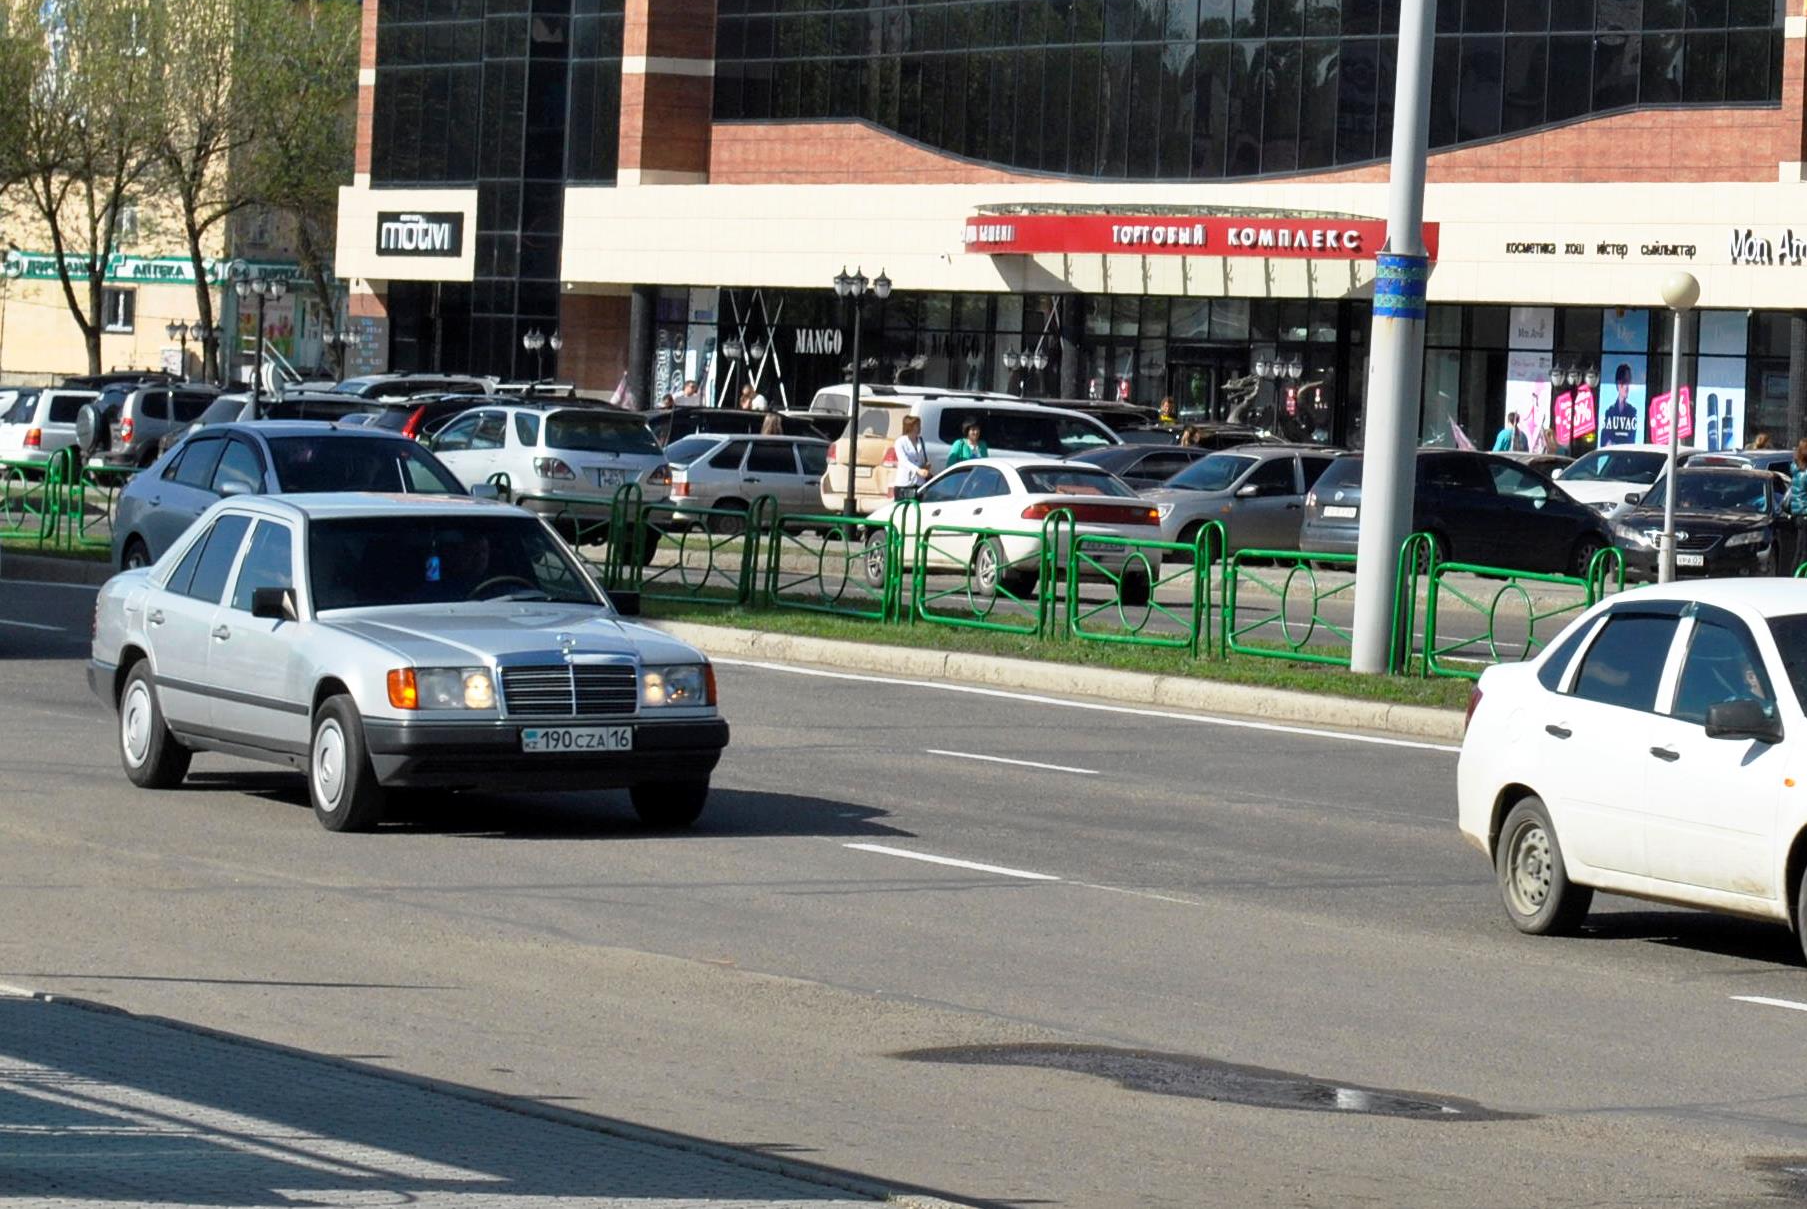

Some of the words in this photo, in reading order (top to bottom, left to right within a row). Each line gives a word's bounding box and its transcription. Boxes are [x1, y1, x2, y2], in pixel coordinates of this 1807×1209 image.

[1112, 223, 1207, 247] ТОРГОВЫЙ
[1227, 226, 1362, 250] КОМПЛЕКС
[1505, 241, 1557, 255] косметика
[1729, 228, 1773, 265] Mon
[132, 263, 187, 279] АПТЕКА
[795, 328, 843, 355] MANGO
[540, 730, 573, 749] 190
[574, 733, 606, 749] CZA
[609, 729, 629, 748] 16
